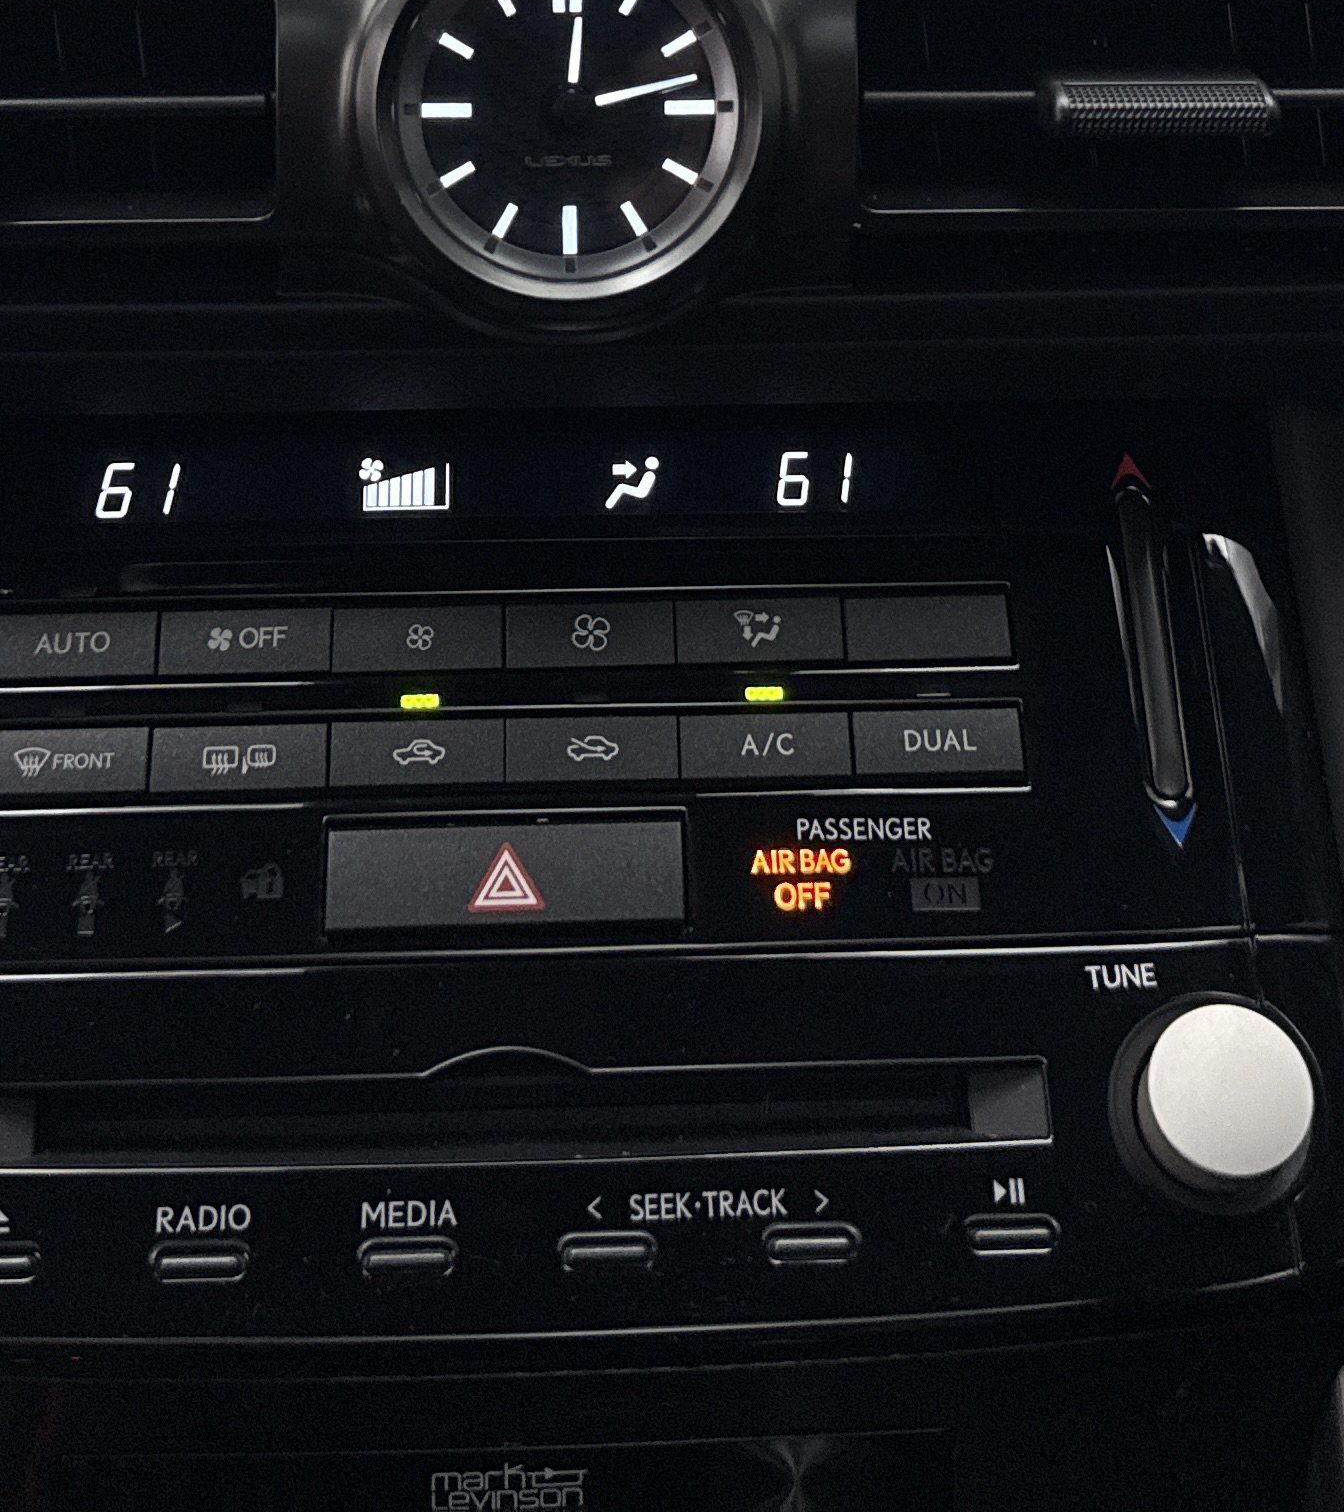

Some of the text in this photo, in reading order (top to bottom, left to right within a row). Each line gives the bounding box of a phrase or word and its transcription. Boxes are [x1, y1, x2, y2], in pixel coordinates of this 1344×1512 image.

[524, 153, 613, 169] LEXUS
[95, 462, 181, 520] 61
[776, 451, 854, 507] 61
[34, 630, 111, 656] AUTO
[238, 625, 288, 650] OFF
[741, 732, 795, 757] A/C
[903, 728, 978, 752] DUAL
[52, 750, 115, 770] FRONT
[796, 817, 932, 841] PASSENGER
[66, 853, 114, 871] REAR
[151, 849, 199, 868] REAR
[891, 846, 994, 874] AIR BAG
[773, 881, 832, 911] OFF
[924, 883, 968, 907] ON
[1084, 962, 1159, 990] TUNE
[155, 1203, 252, 1234] RADIO
[360, 1199, 458, 1229] MEDIA
[430, 1462, 526, 1491] mark
